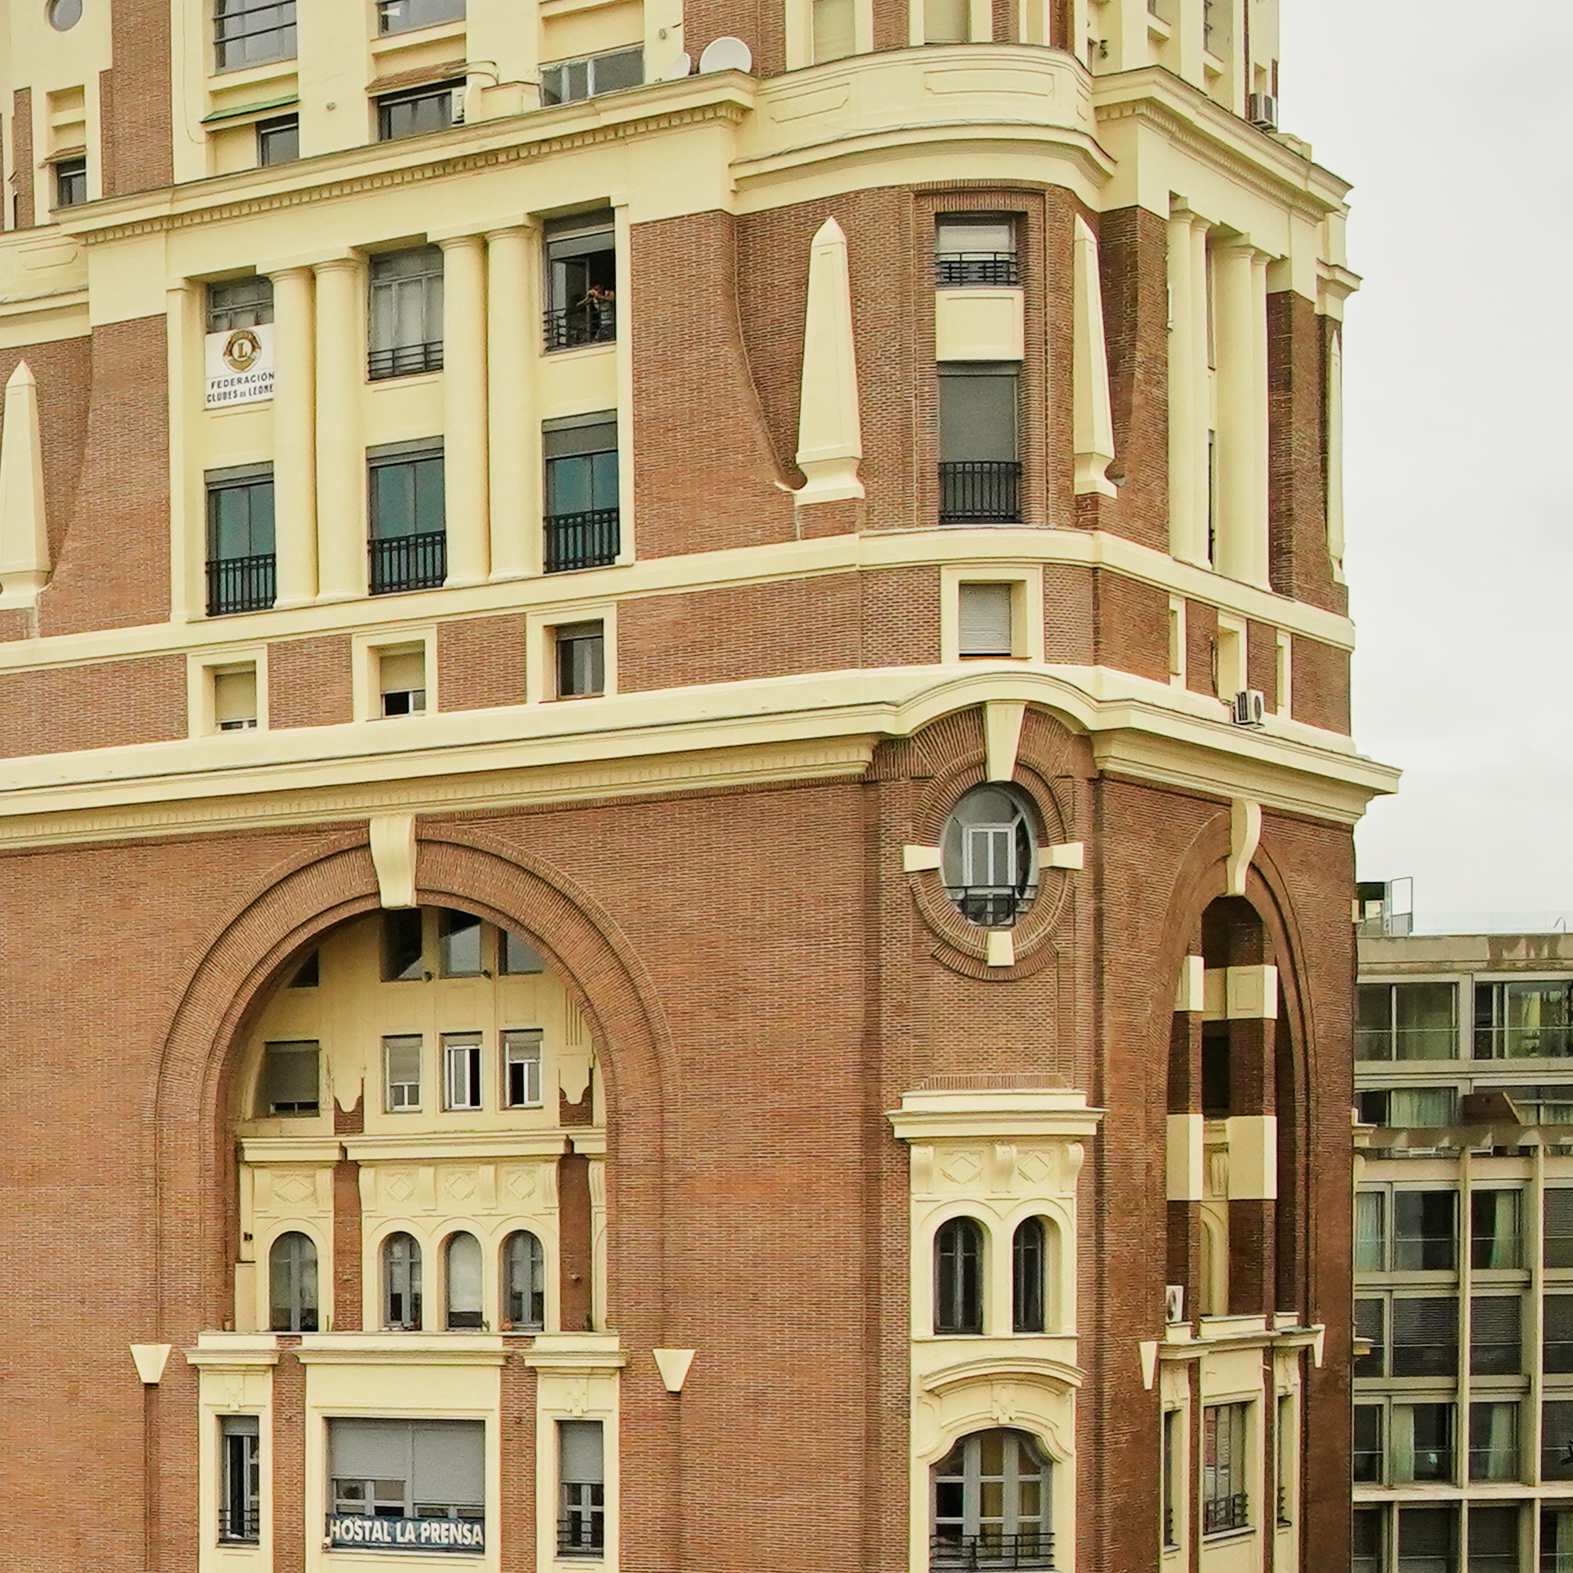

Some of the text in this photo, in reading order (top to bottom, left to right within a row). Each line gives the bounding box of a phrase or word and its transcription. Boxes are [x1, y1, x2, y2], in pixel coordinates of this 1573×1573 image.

[211, 371, 275, 390] FEDERACIÓN
[207, 389, 238, 403] CLUBES
[249, 384, 274, 397] LEONE
[329, 1519, 484, 1546] HOSTAL LA PRENSA
